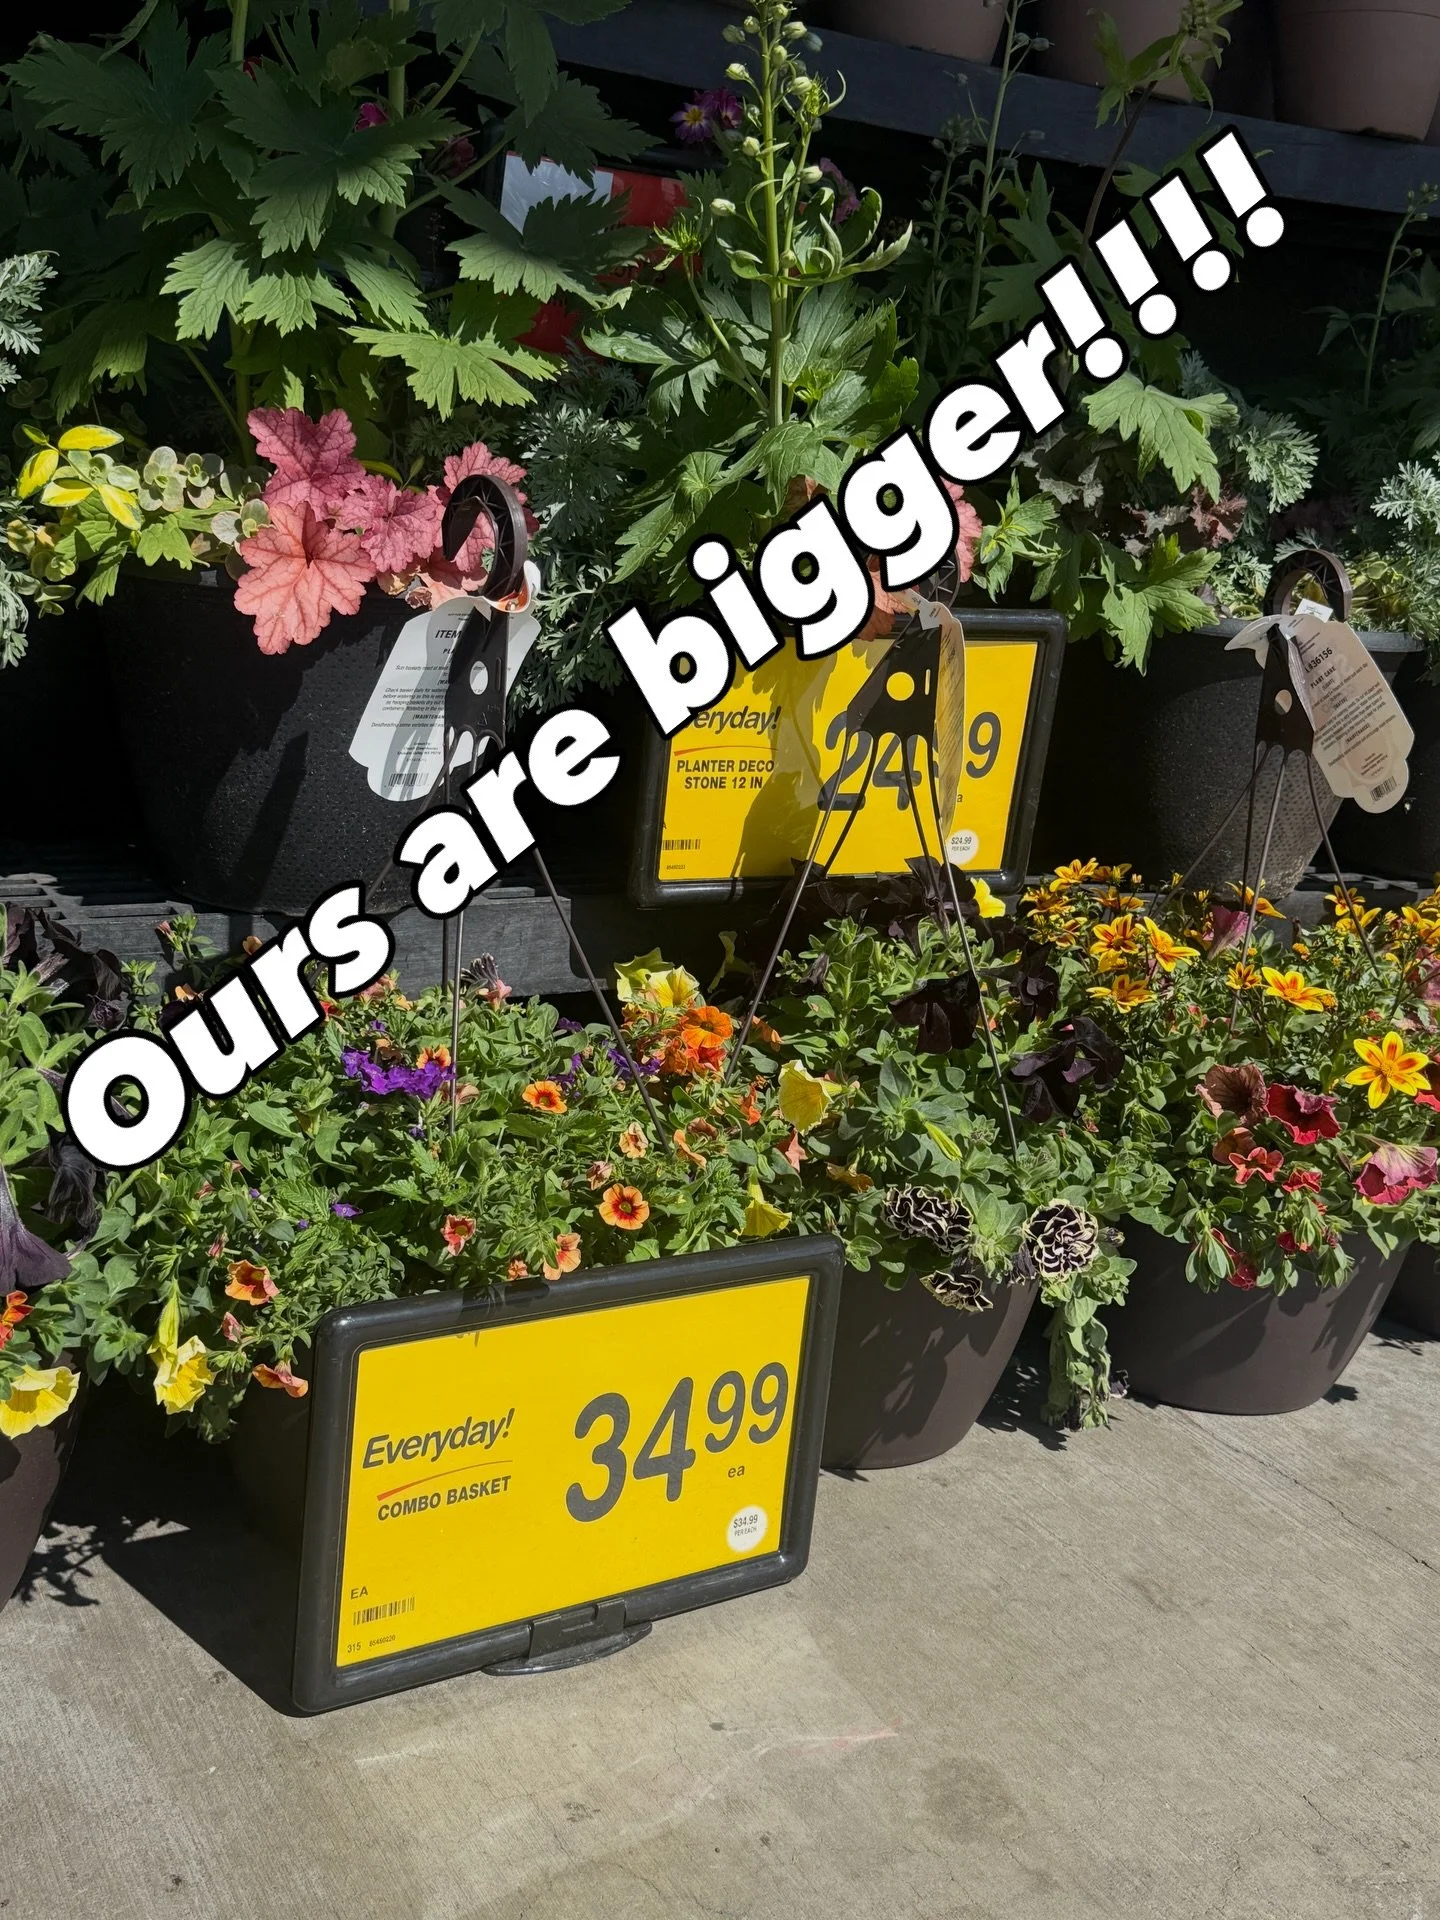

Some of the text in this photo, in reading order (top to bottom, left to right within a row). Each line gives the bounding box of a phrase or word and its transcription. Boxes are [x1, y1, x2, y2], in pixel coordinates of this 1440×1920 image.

[690, 705, 782, 735] eryday!
[676, 760, 775, 773] PLANTER DECO
[684, 776, 763, 789] STONE 12 IN
[362, 1407, 516, 1470] Everyday!
[727, 1463, 746, 1478] ea
[377, 1475, 512, 1521] COMBO BASKET
[733, 1513, 759, 1529] $34.99
[350, 1586, 369, 1600] EA
[347, 1642, 362, 1653] 315
